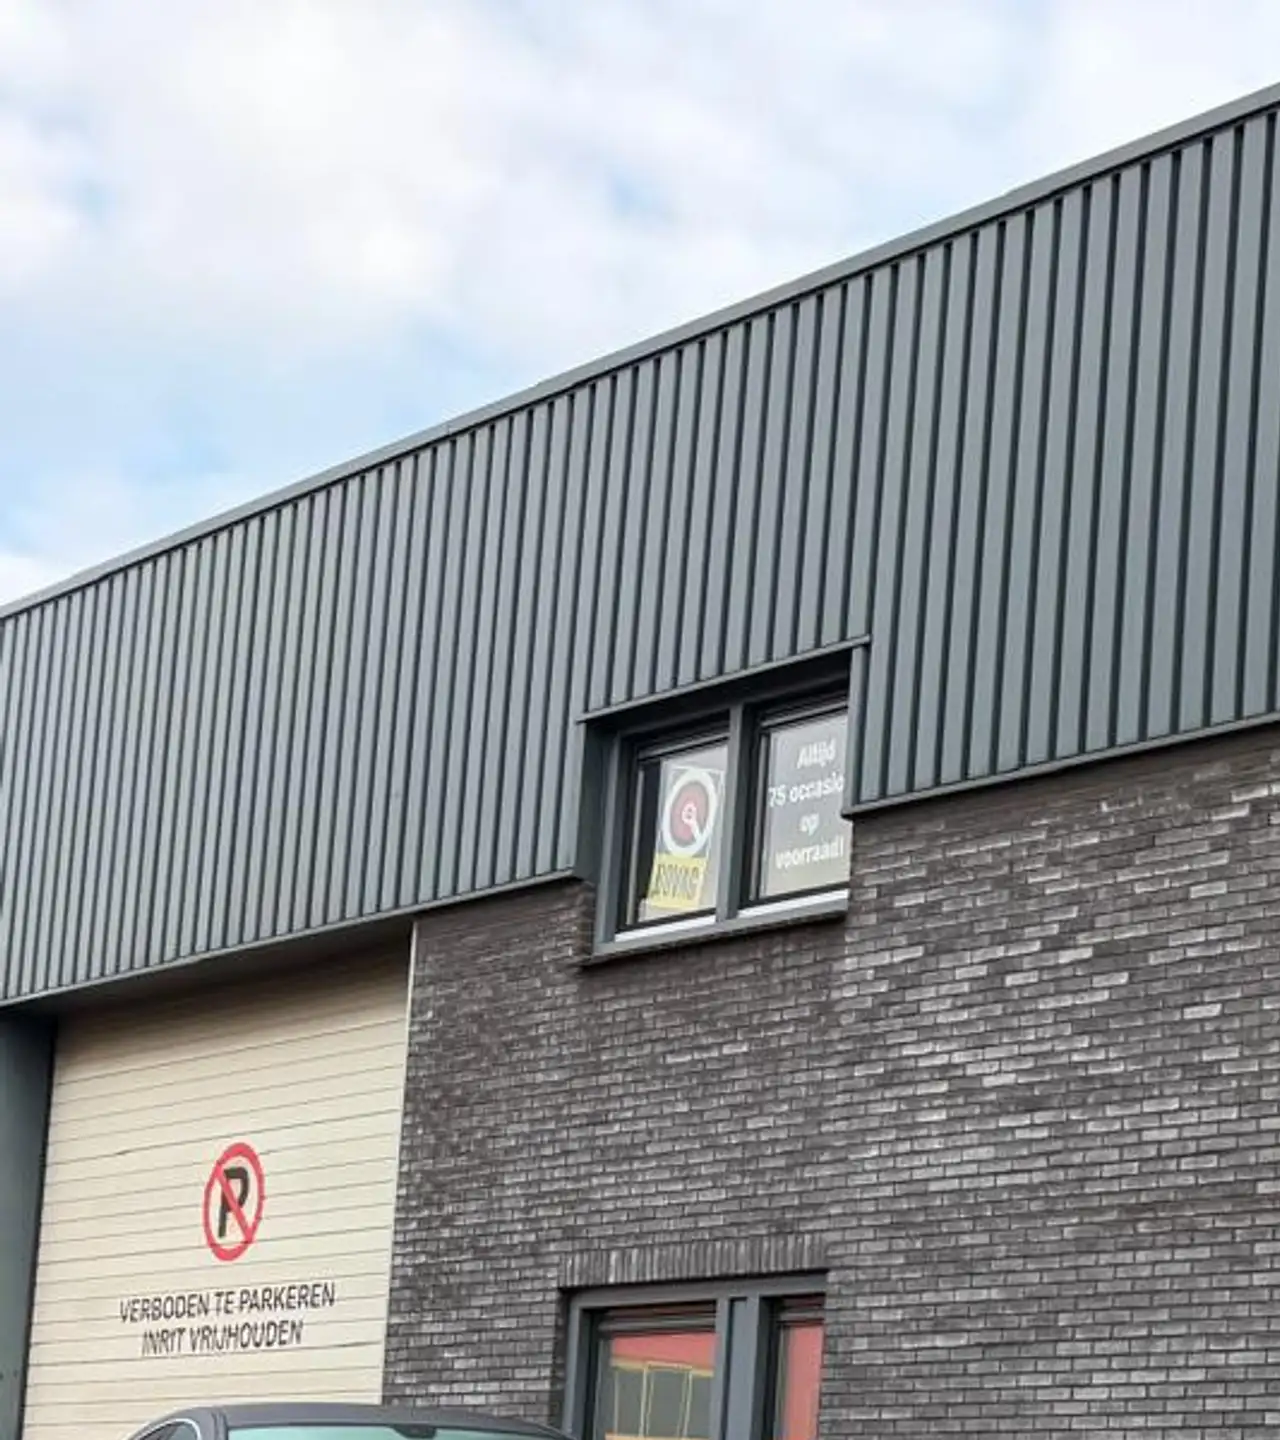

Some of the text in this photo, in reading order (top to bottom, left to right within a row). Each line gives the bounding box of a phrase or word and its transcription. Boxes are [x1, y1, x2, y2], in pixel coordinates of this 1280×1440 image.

[120, 1282, 336, 1323] VERBODEN TE PARKEREN
[142, 1320, 304, 1355] INRIT VRIJHOUDEN
